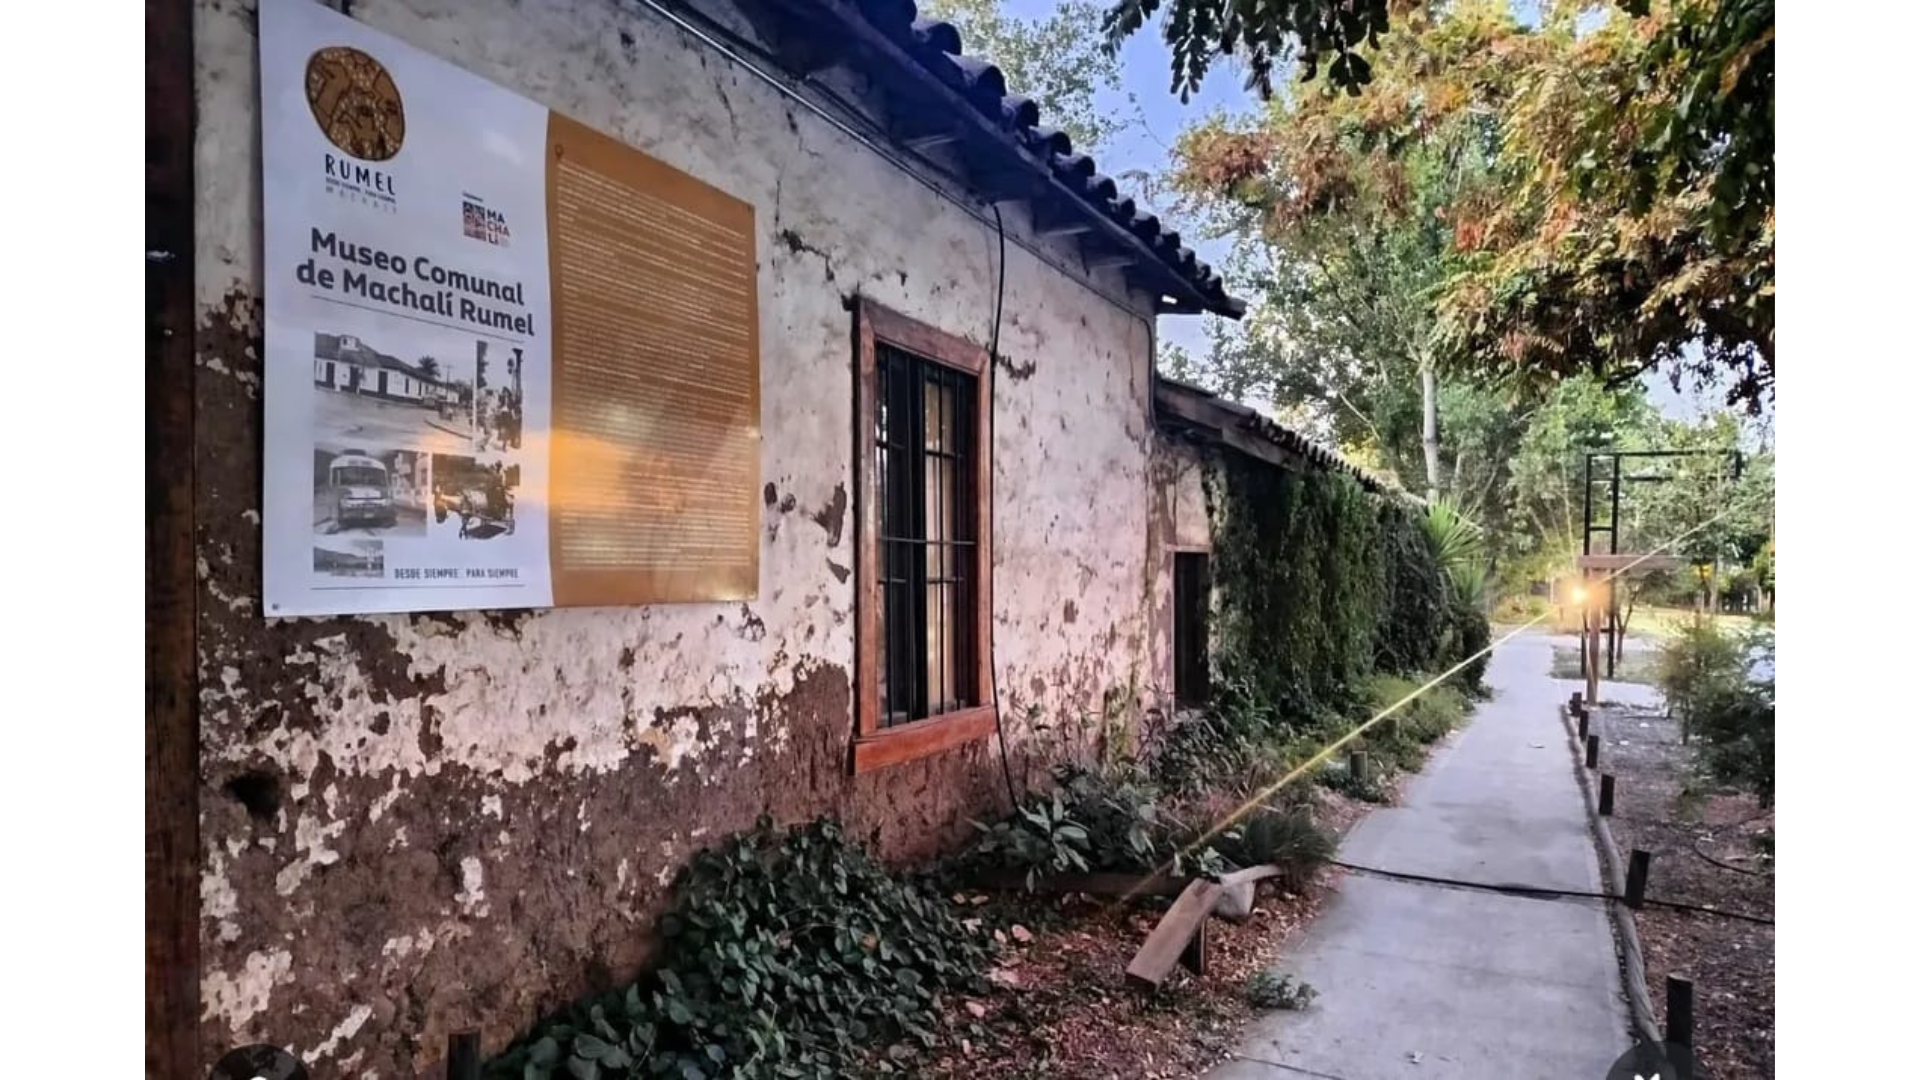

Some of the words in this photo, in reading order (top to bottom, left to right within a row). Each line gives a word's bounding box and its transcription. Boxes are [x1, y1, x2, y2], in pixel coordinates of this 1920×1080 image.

[325, 153, 396, 195] RUMEL
[487, 209, 505, 224] MA
[311, 227, 407, 274] Museo
[413, 256, 525, 306] Comunal
[296, 259, 334, 289] de
[343, 269, 453, 317] Machalí
[460, 298, 535, 336] Rumel
